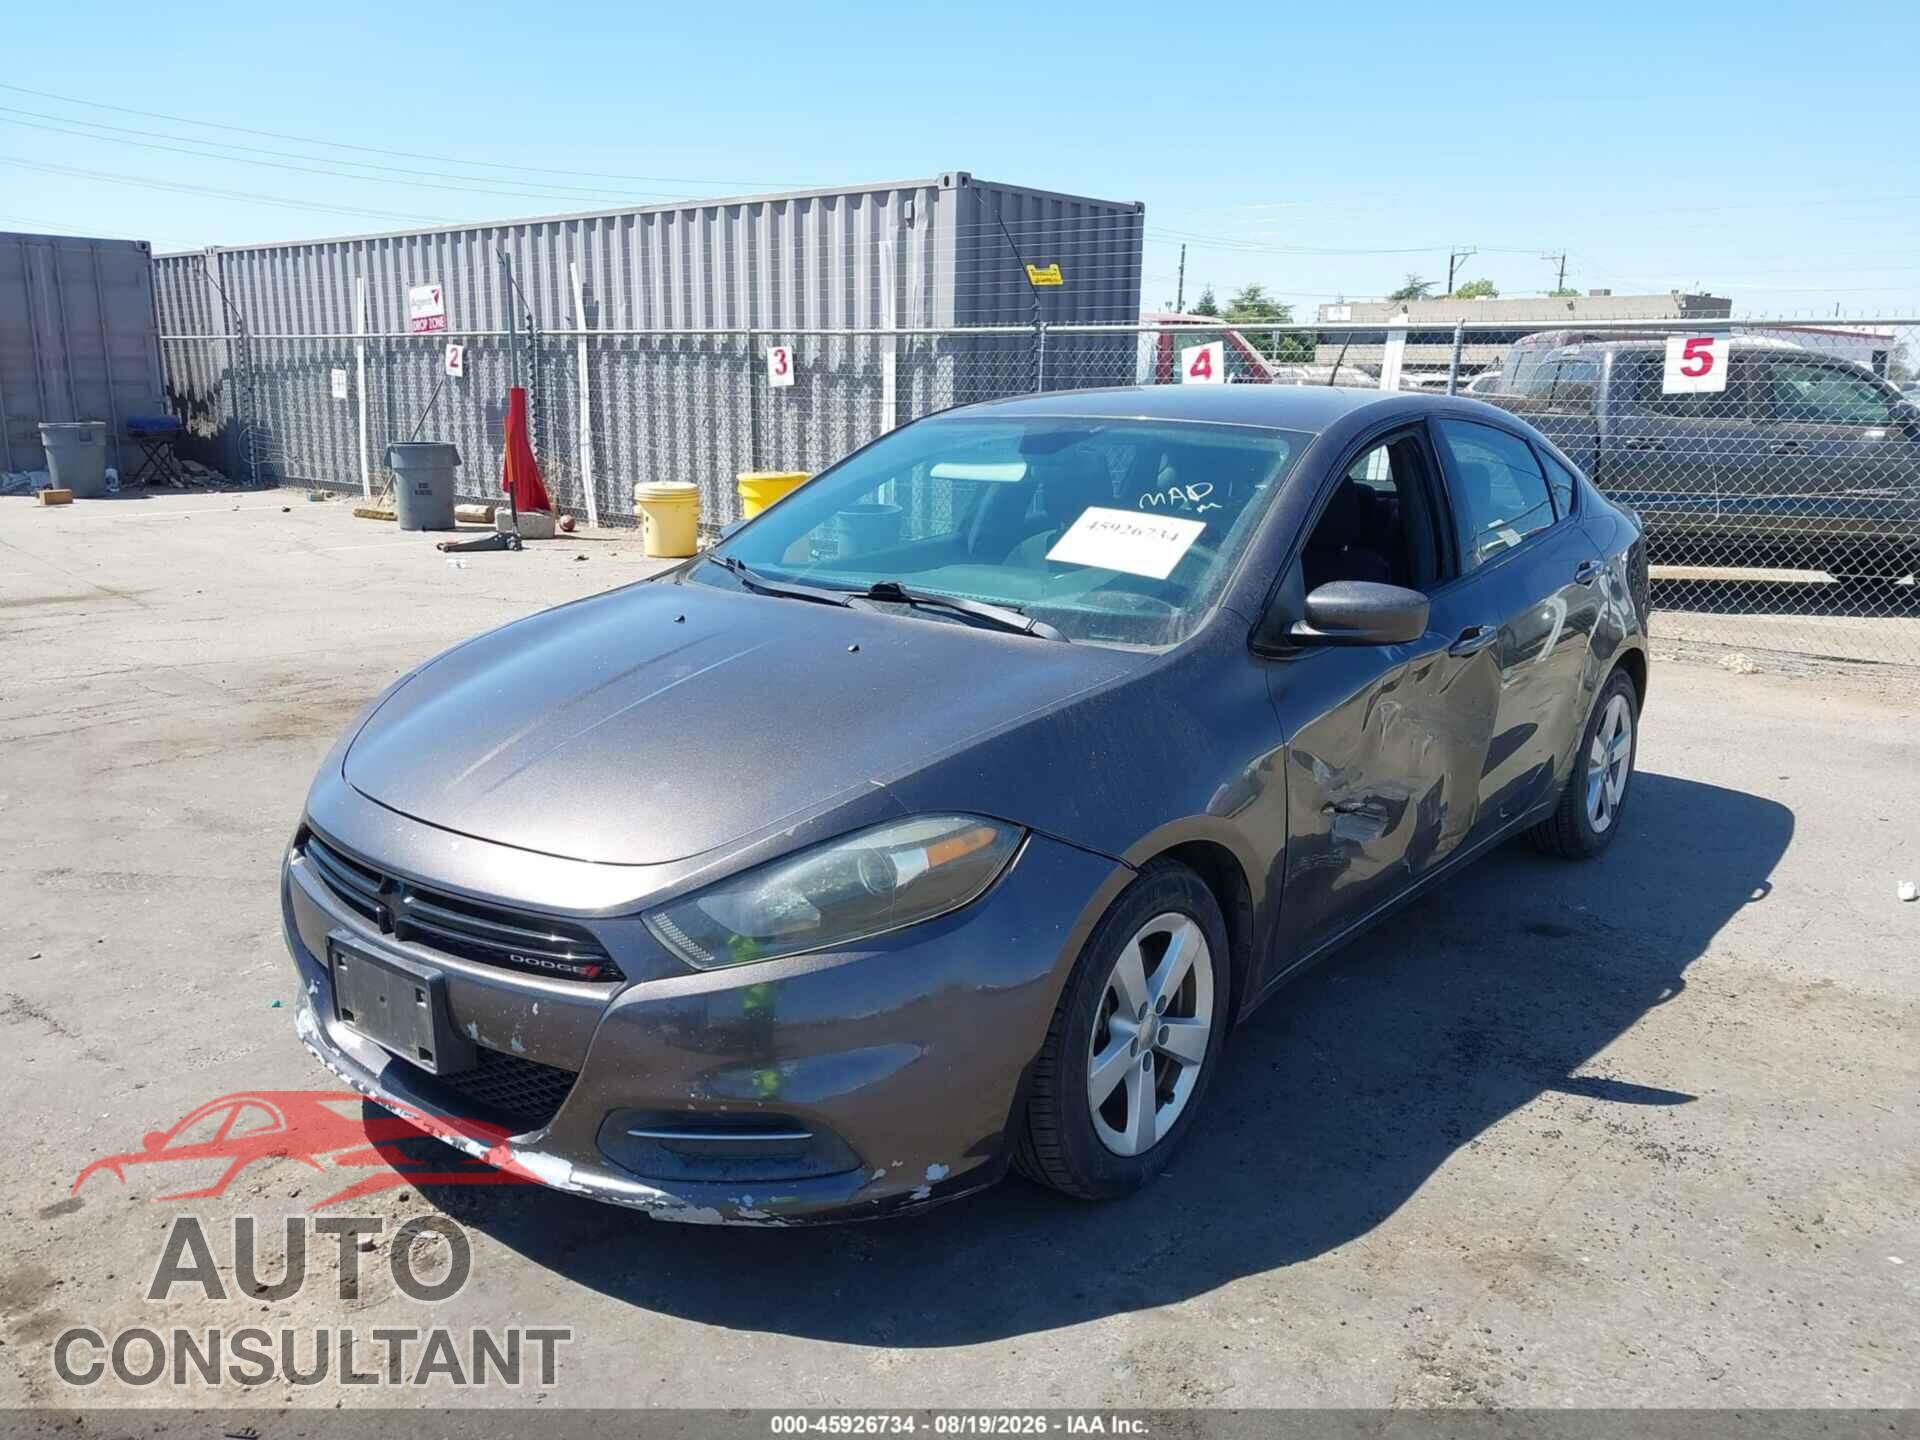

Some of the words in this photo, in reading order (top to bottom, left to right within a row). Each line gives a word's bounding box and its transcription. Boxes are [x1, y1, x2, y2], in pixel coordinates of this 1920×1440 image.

[449, 347, 459, 369] 2
[774, 349, 787, 375] 3
[1190, 349, 1211, 379] 4
[1680, 337, 1714, 377] 5
[510, 954, 587, 975] DODGE
